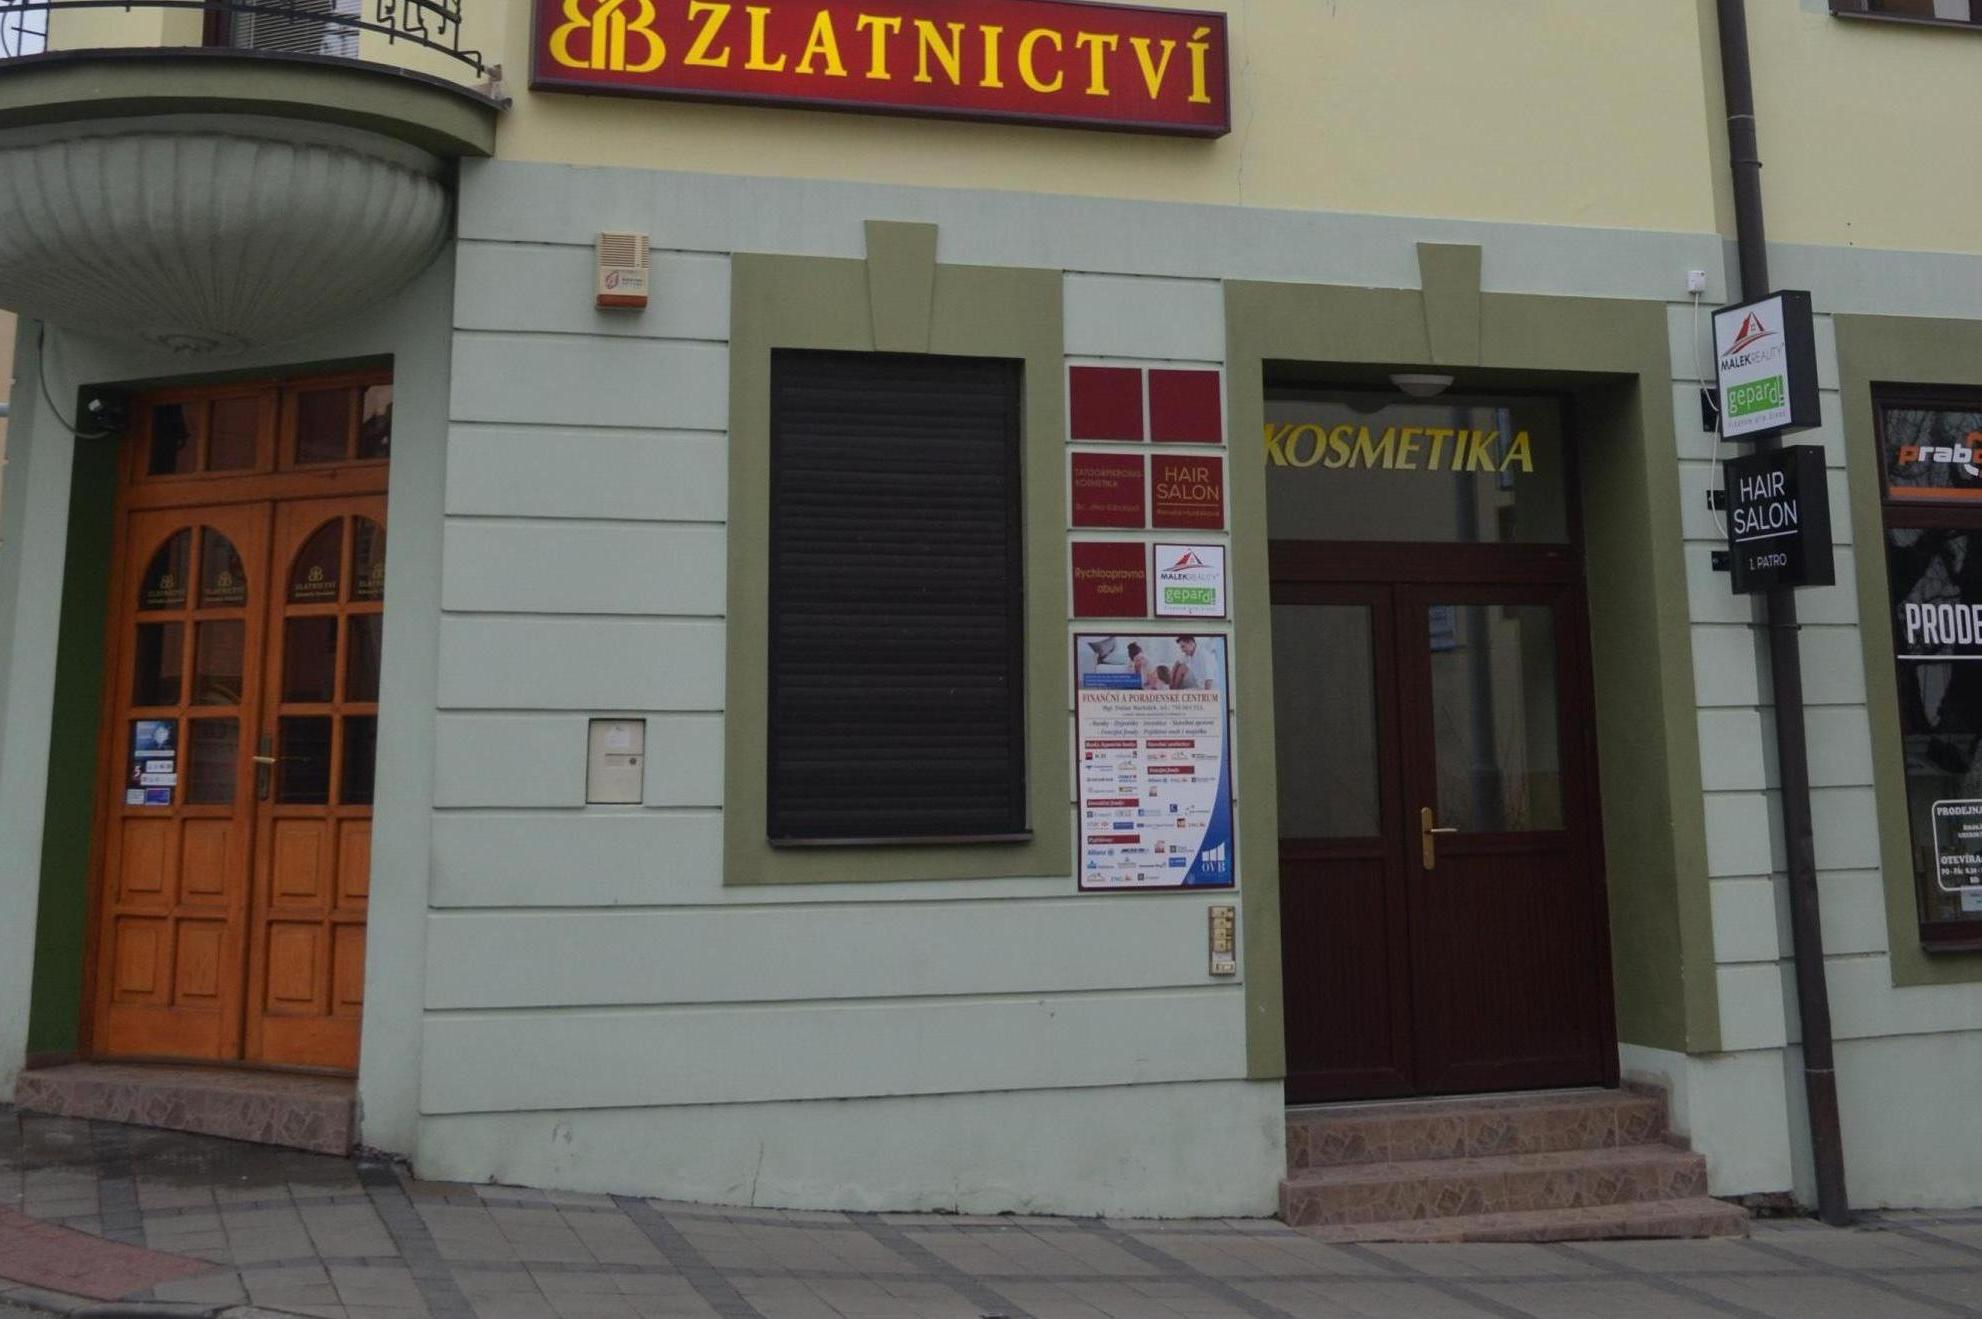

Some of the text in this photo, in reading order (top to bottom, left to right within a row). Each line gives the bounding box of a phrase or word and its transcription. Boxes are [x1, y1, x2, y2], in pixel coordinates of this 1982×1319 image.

[683, 0, 1211, 103] ZLATNICTVÍ
[1264, 423, 1534, 473] KOSMETIKA
[1164, 467, 1209, 482] HAIR
[1156, 483, 1220, 501] SALON
[1740, 471, 1785, 502] HAIR
[1734, 500, 1798, 533] SALON
[1757, 553, 1787, 568] PATRO
[1181, 693, 1219, 703] CENTRUM
[1202, 862, 1226, 873] OVB
